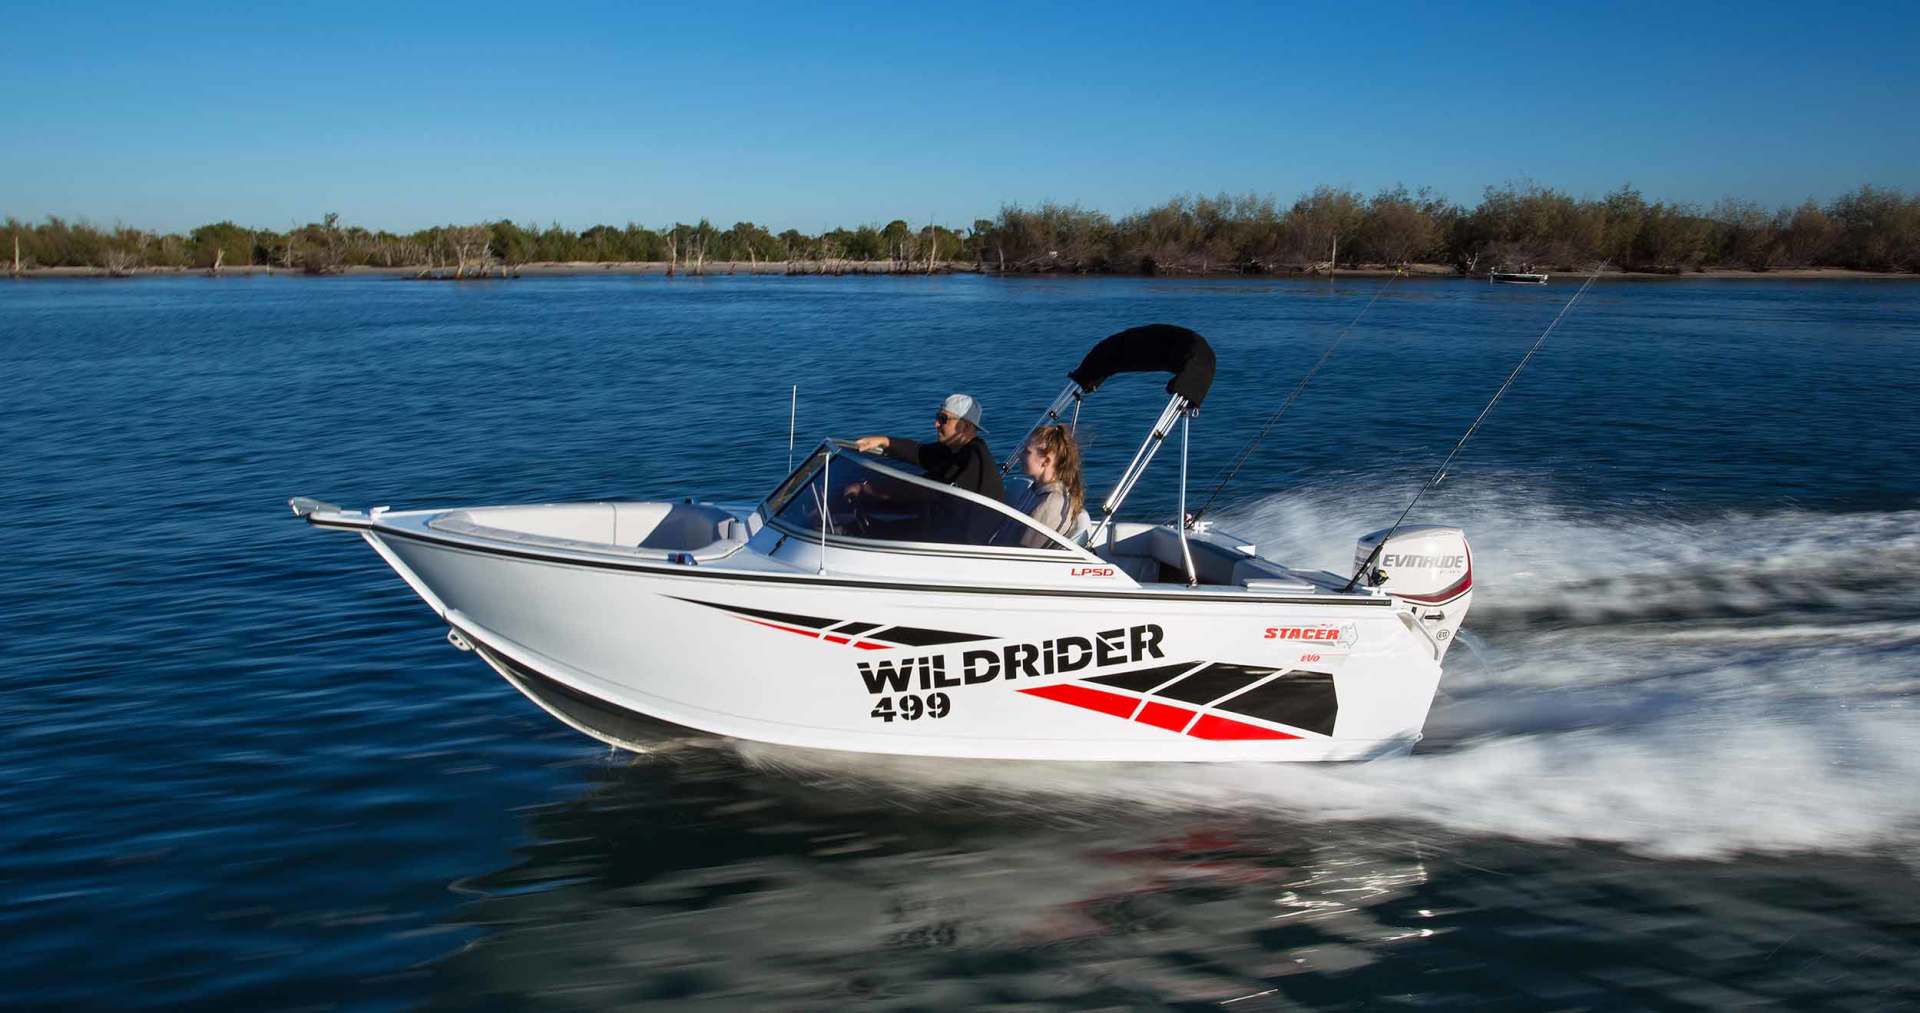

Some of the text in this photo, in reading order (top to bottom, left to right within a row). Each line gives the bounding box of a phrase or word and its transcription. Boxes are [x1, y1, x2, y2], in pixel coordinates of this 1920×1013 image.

[1382, 554, 1464, 568] EVINRUDE
[1071, 568, 1114, 576] LPSD
[1264, 628, 1339, 639] STACER
[871, 692, 951, 722] 499
